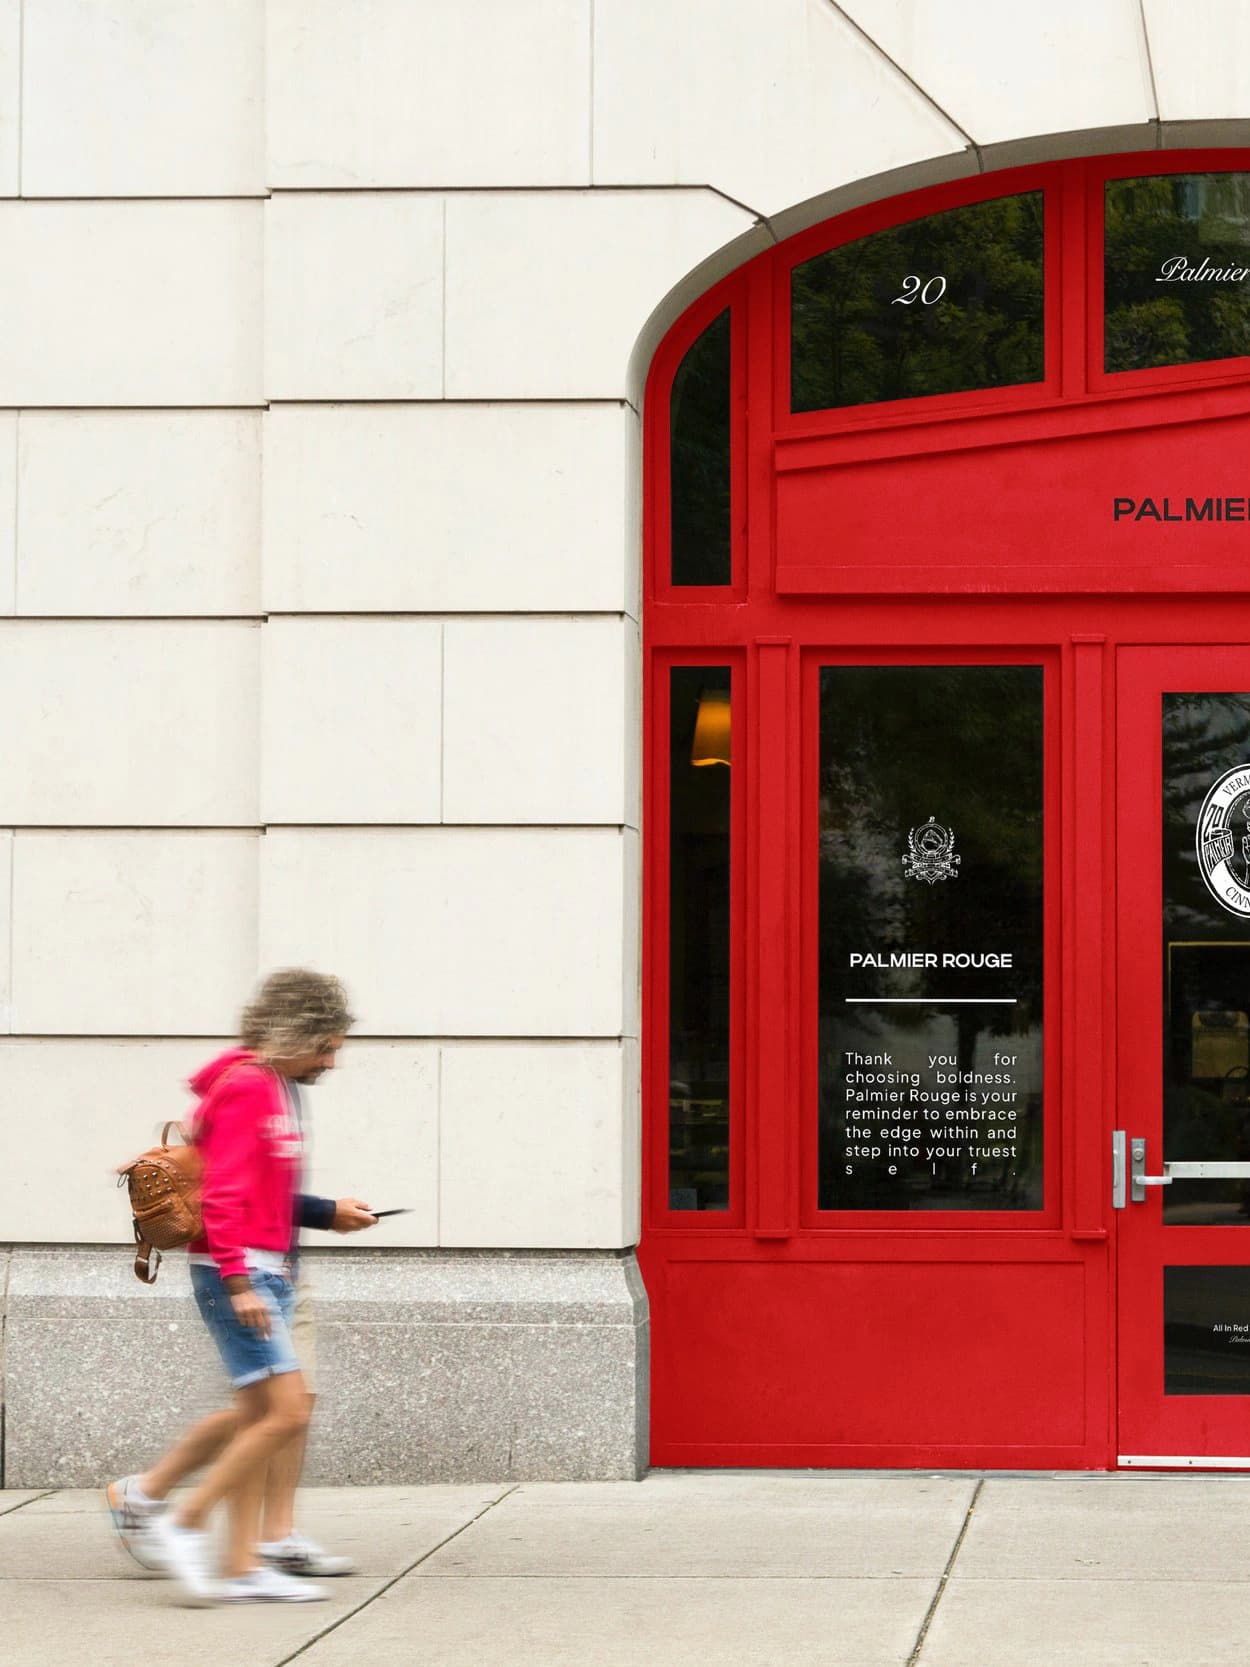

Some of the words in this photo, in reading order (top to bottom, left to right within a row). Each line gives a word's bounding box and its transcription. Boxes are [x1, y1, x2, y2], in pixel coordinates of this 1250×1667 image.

[891, 275, 947, 306] 20
[1204, 803, 1225, 841] 20
[849, 953, 938, 968] PALMIER
[942, 953, 1013, 968] ROUGE
[844, 1051, 893, 1066] Thank
[928, 1054, 958, 1069] you
[993, 1052, 1018, 1066] for
[845, 1070, 921, 1087] choosing
[936, 1070, 1017, 1085] boldness.
[845, 1088, 906, 1102] Palmier
[909, 1088, 961, 1105] Rouge
[965, 1089, 977, 1102] is
[981, 1091, 1018, 1106] your
[845, 1107, 919, 1121] reminder
[922, 1108, 940, 1121] to
[945, 1107, 1017, 1121] embrace
[845, 1125, 872, 1139] the
[879, 1125, 922, 1142] edge
[929, 1125, 979, 1139] within
[987, 1125, 1017, 1140] and
[845, 1145, 881, 1160] step
[888, 1143, 920, 1158] into
[926, 1147, 962, 1161] your
[968, 1144, 1017, 1158] truest
[1213, 1324, 1223, 1332] All
[1224, 1324, 1232, 1332] In
[1233, 1324, 1249, 1332] Red
